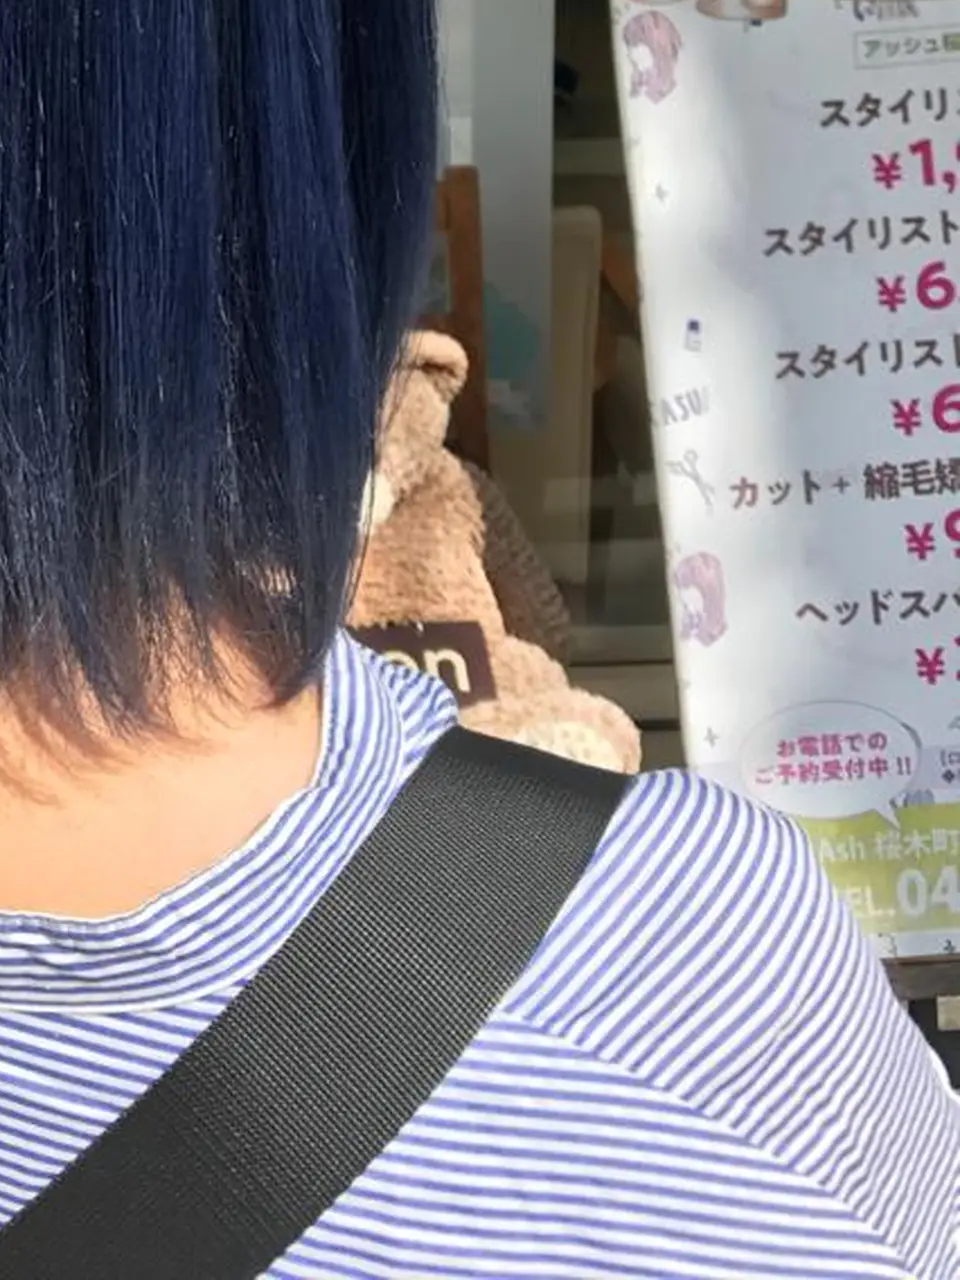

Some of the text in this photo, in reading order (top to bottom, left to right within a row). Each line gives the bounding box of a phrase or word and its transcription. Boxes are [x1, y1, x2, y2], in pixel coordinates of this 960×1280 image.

[819, 86, 960, 127] スタイリ
[872, 138, 960, 194] ¥1,
[763, 209, 959, 257] スタイリスト
[776, 732, 887, 758] お電話での
[820, 834, 865, 863] Ash
